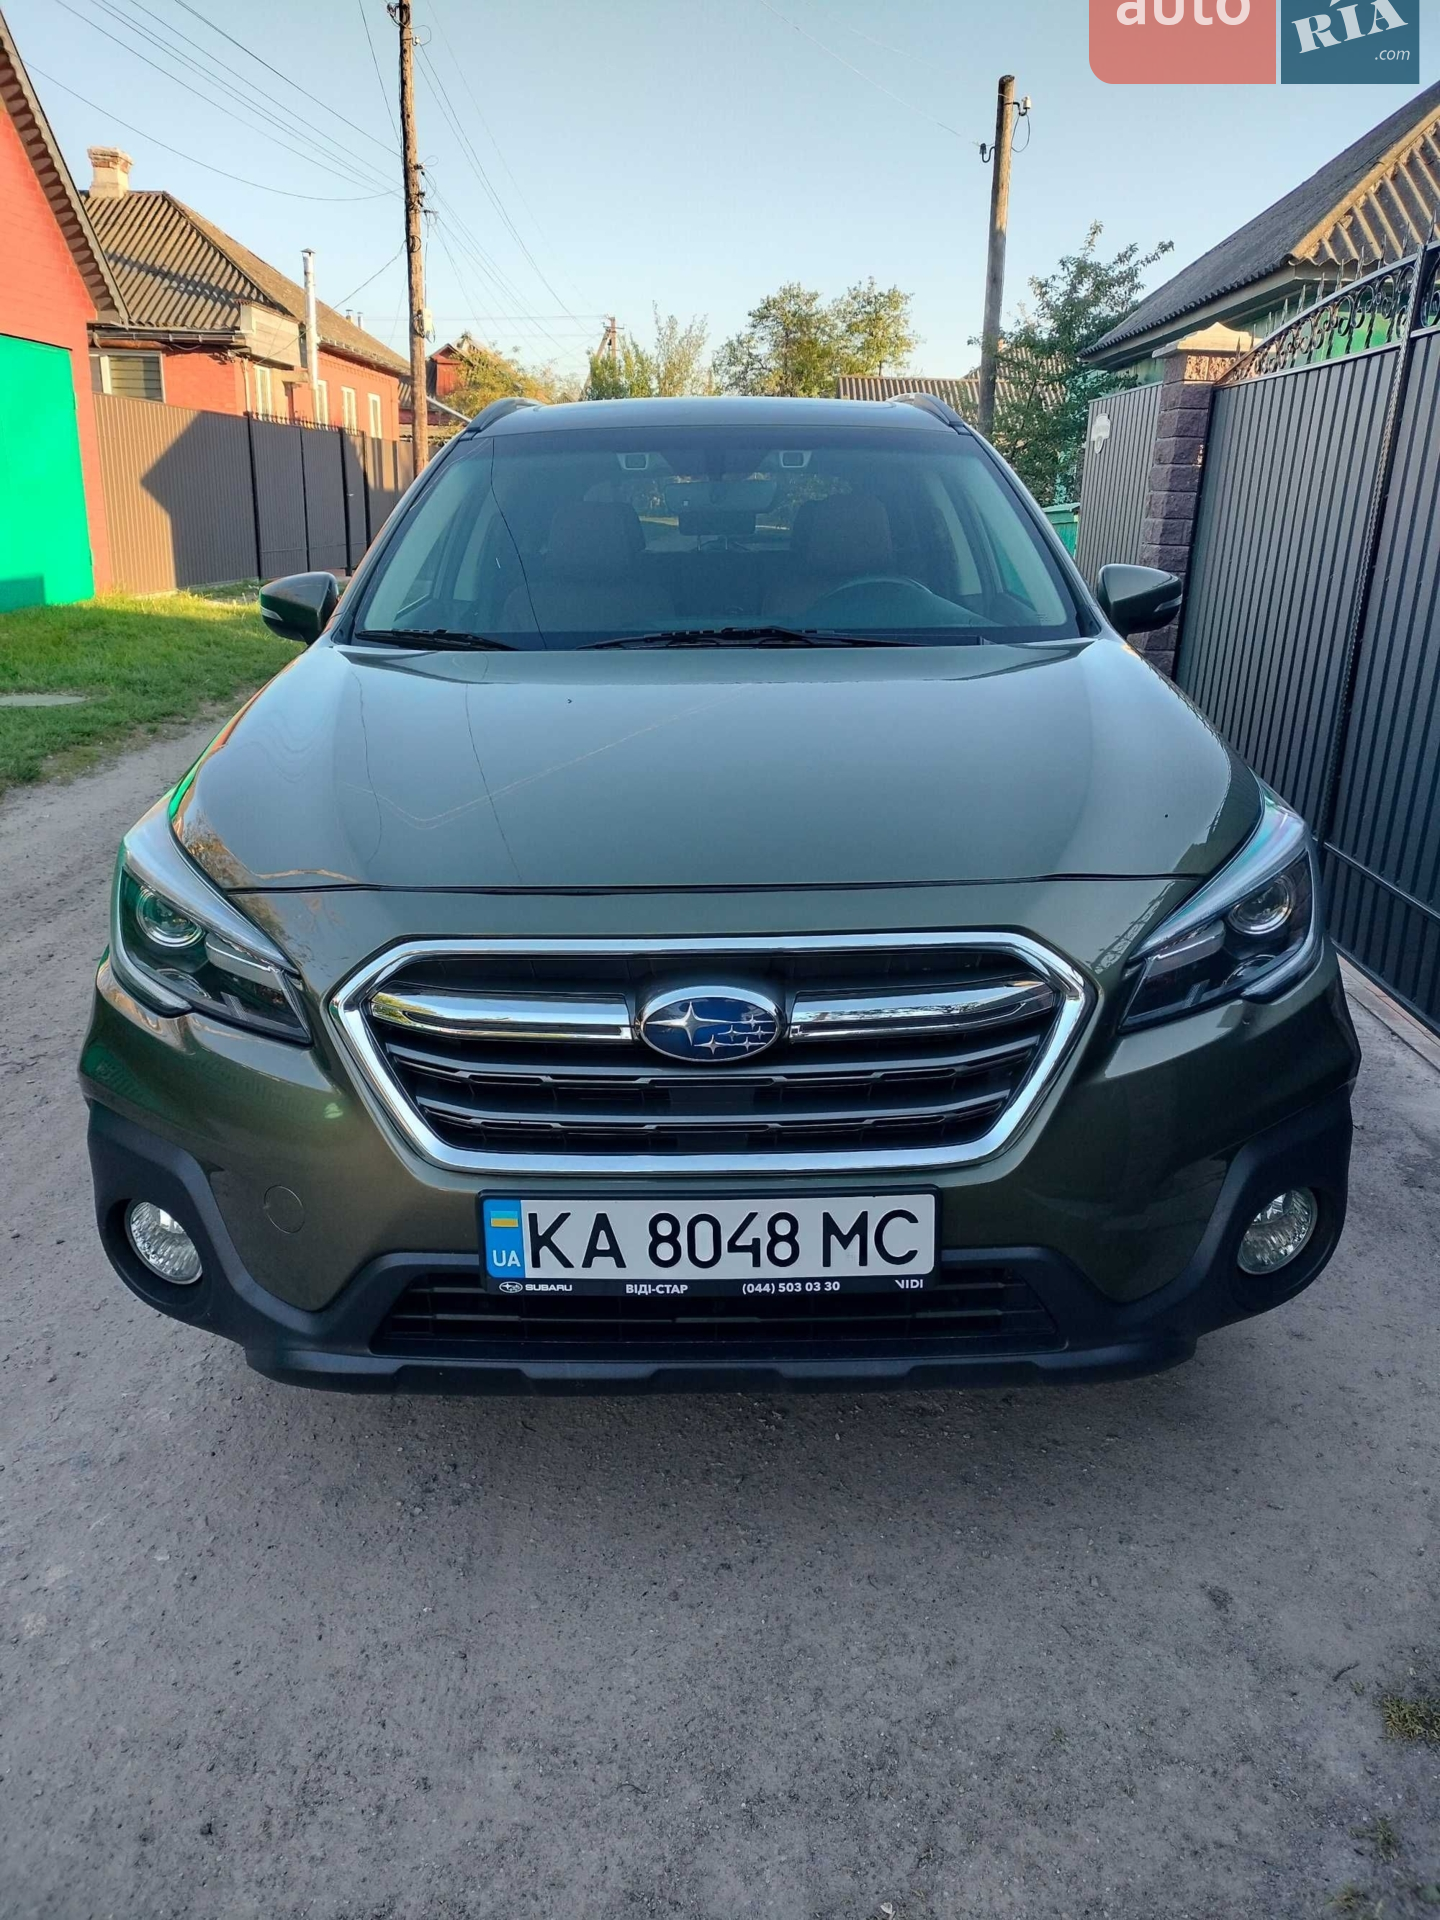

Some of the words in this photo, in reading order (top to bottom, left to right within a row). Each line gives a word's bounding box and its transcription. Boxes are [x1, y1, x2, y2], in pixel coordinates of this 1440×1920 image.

[527, 1212, 627, 1269] KA
[648, 1211, 800, 1268] 8048
[822, 1209, 919, 1267] MC
[493, 1249, 521, 1267] UA
[525, 1284, 573, 1292] SUBARU
[625, 1284, 688, 1295] ВІДІ-СТАР
[742, 1283, 775, 1295] (044)
[778, 1282, 802, 1293] 503
[805, 1282, 821, 1292] 03
[824, 1281, 840, 1291] 30
